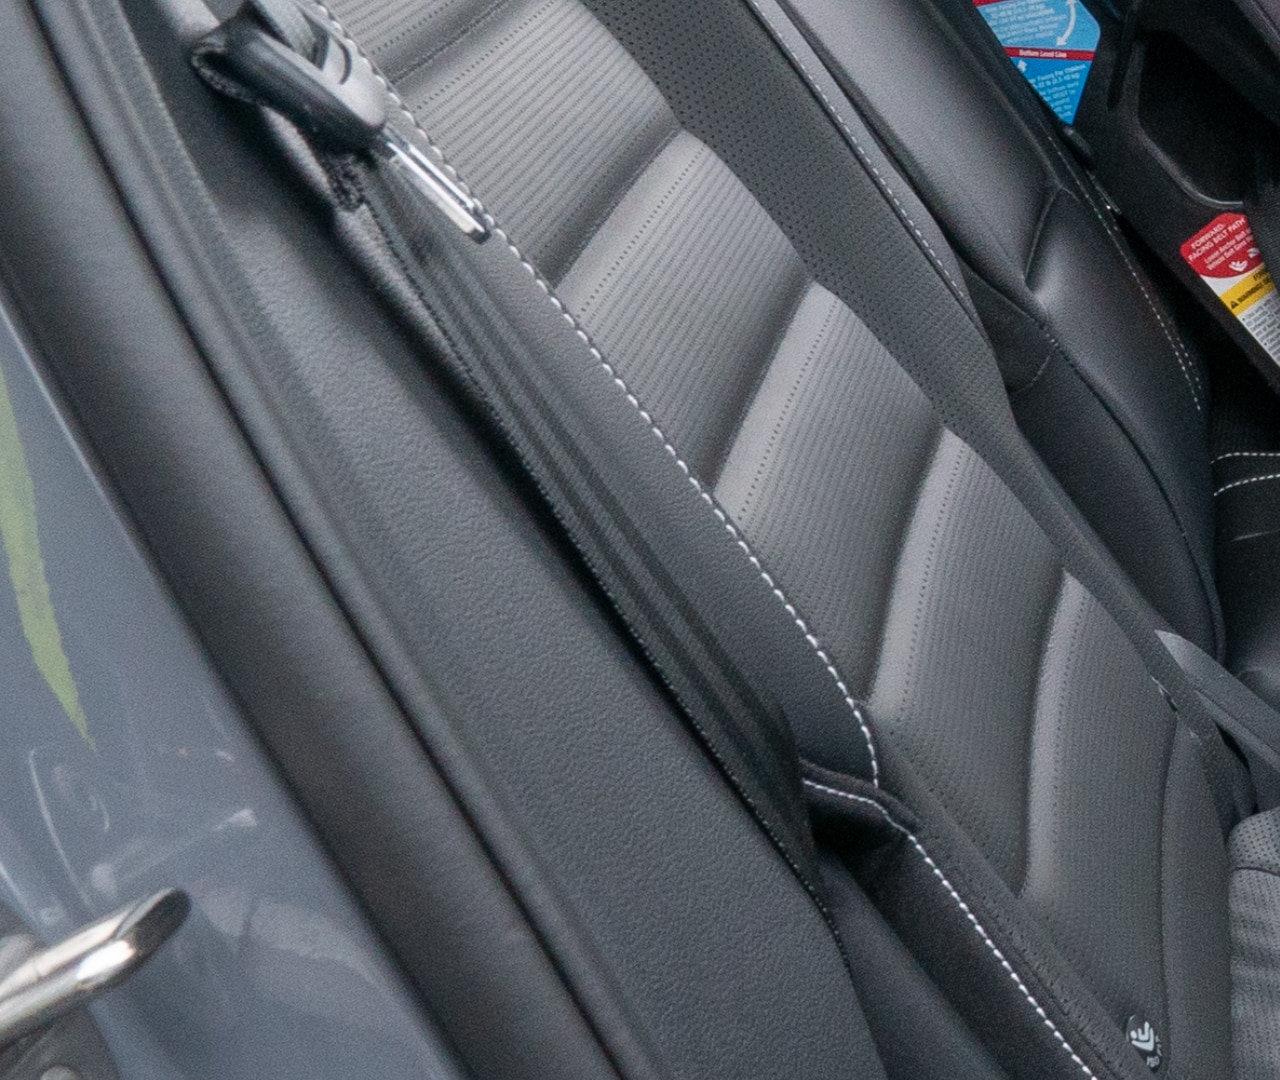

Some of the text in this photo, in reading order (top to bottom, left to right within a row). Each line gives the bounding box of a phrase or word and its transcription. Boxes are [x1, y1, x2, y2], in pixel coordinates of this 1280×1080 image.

[1188, 241, 1214, 260] FACING
[1213, 229, 1229, 244] BELT
[1227, 218, 1246, 232] PATH
